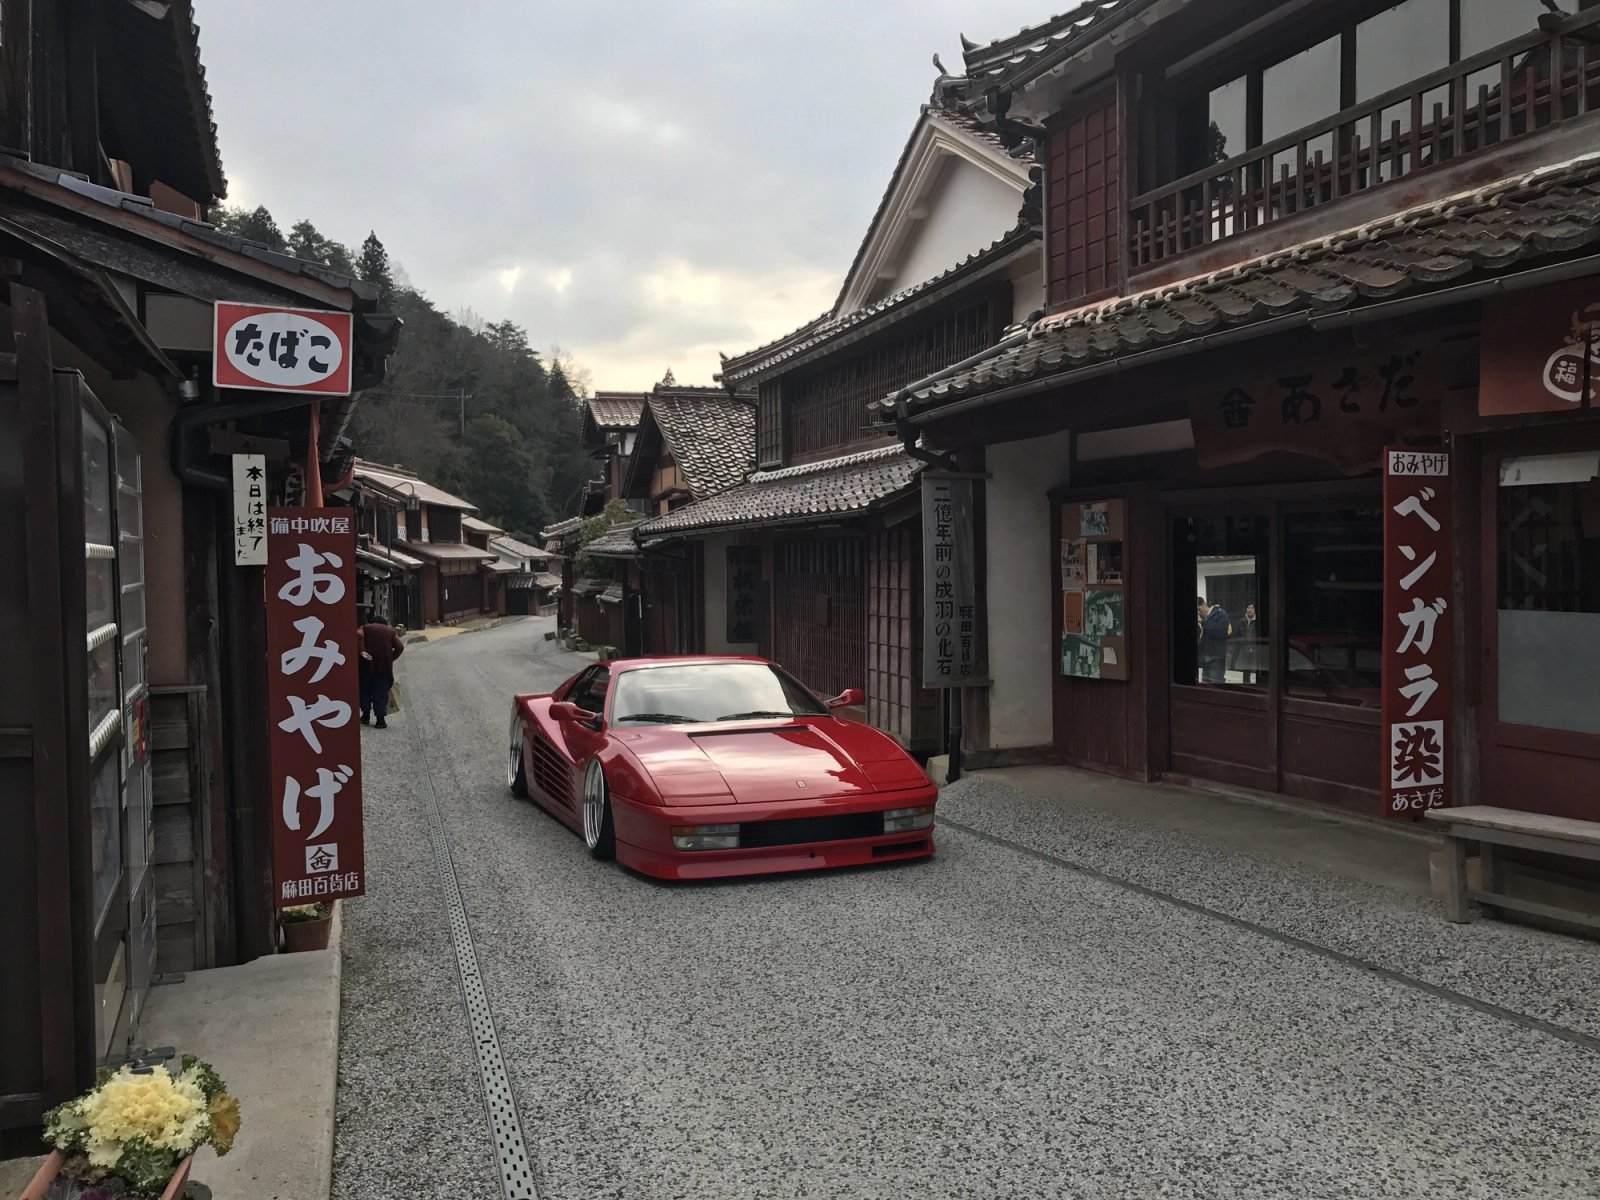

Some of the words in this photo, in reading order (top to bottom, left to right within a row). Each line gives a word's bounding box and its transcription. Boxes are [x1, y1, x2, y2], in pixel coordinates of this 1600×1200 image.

[234, 322, 332, 374] たばこ
[1278, 348, 1423, 425] あさだ
[1555, 360, 1577, 385] 福
[1392, 453, 1447, 475] おみやげ
[246, 465, 265, 552] 本日は終了
[269, 516, 350, 535] 備中吹屋
[236, 515, 248, 560] しました
[934, 486, 954, 675] 二億年前の成羽の化石
[958, 605, 974, 676] 麻田百貨店
[277, 542, 354, 841] おみやげ
[1392, 789, 1444, 812] あさだ
[281, 870, 360, 900] 麻田百貨店
